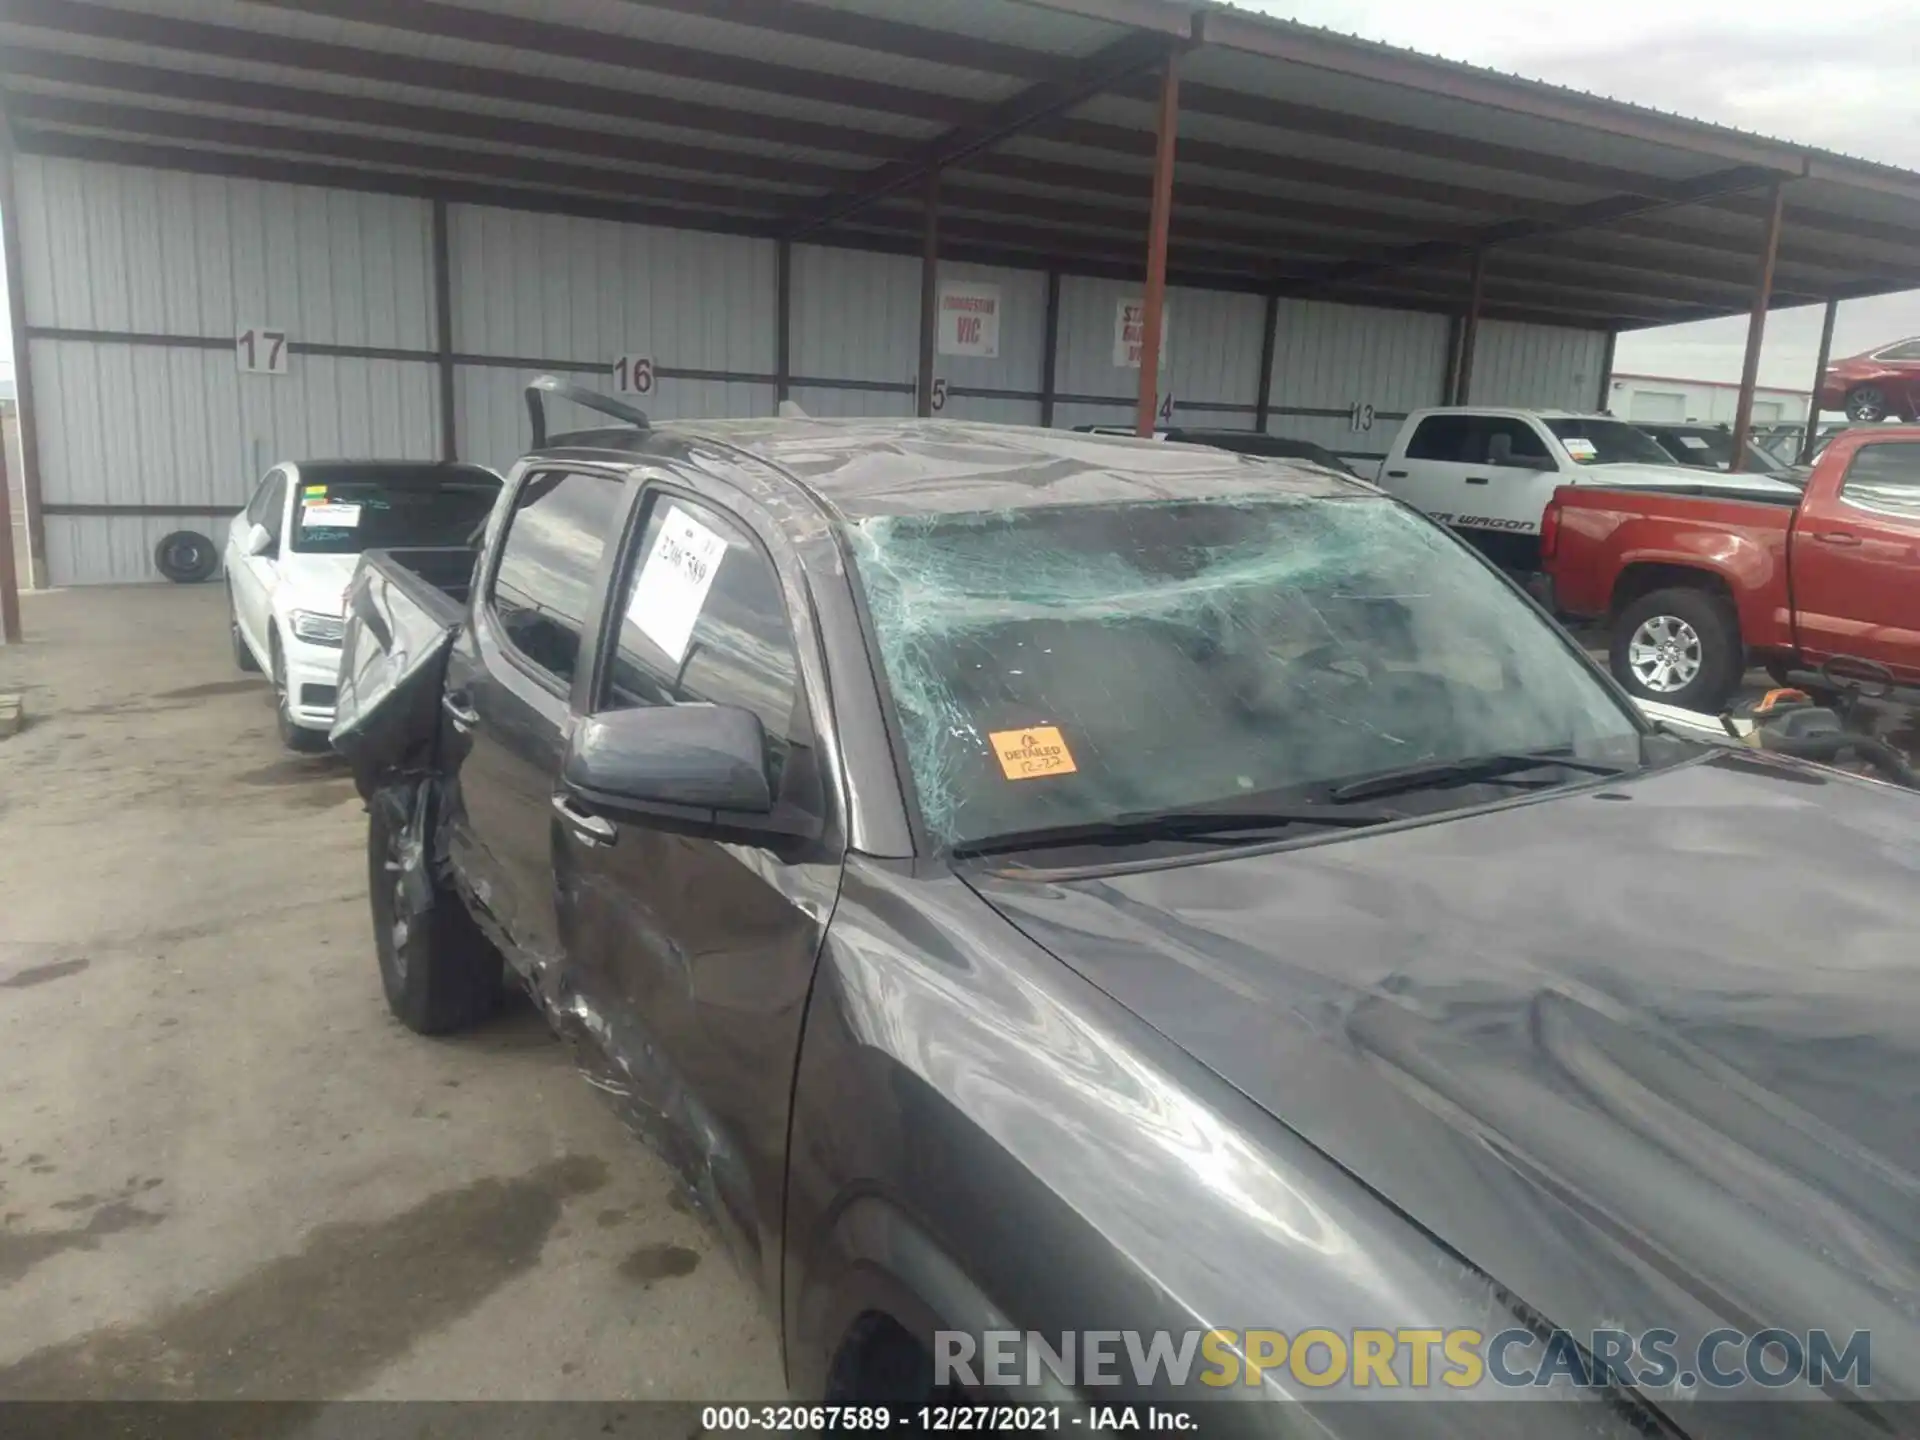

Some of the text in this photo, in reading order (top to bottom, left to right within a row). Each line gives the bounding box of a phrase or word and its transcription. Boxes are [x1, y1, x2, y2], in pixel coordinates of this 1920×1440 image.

[957, 315, 982, 345] VIC
[238, 329, 286, 370] 17
[614, 356, 653, 393] 16
[1353, 402, 1374, 431] 13
[1458, 514, 1536, 531] WAGON
[1004, 746, 1061, 761] DETAILED
